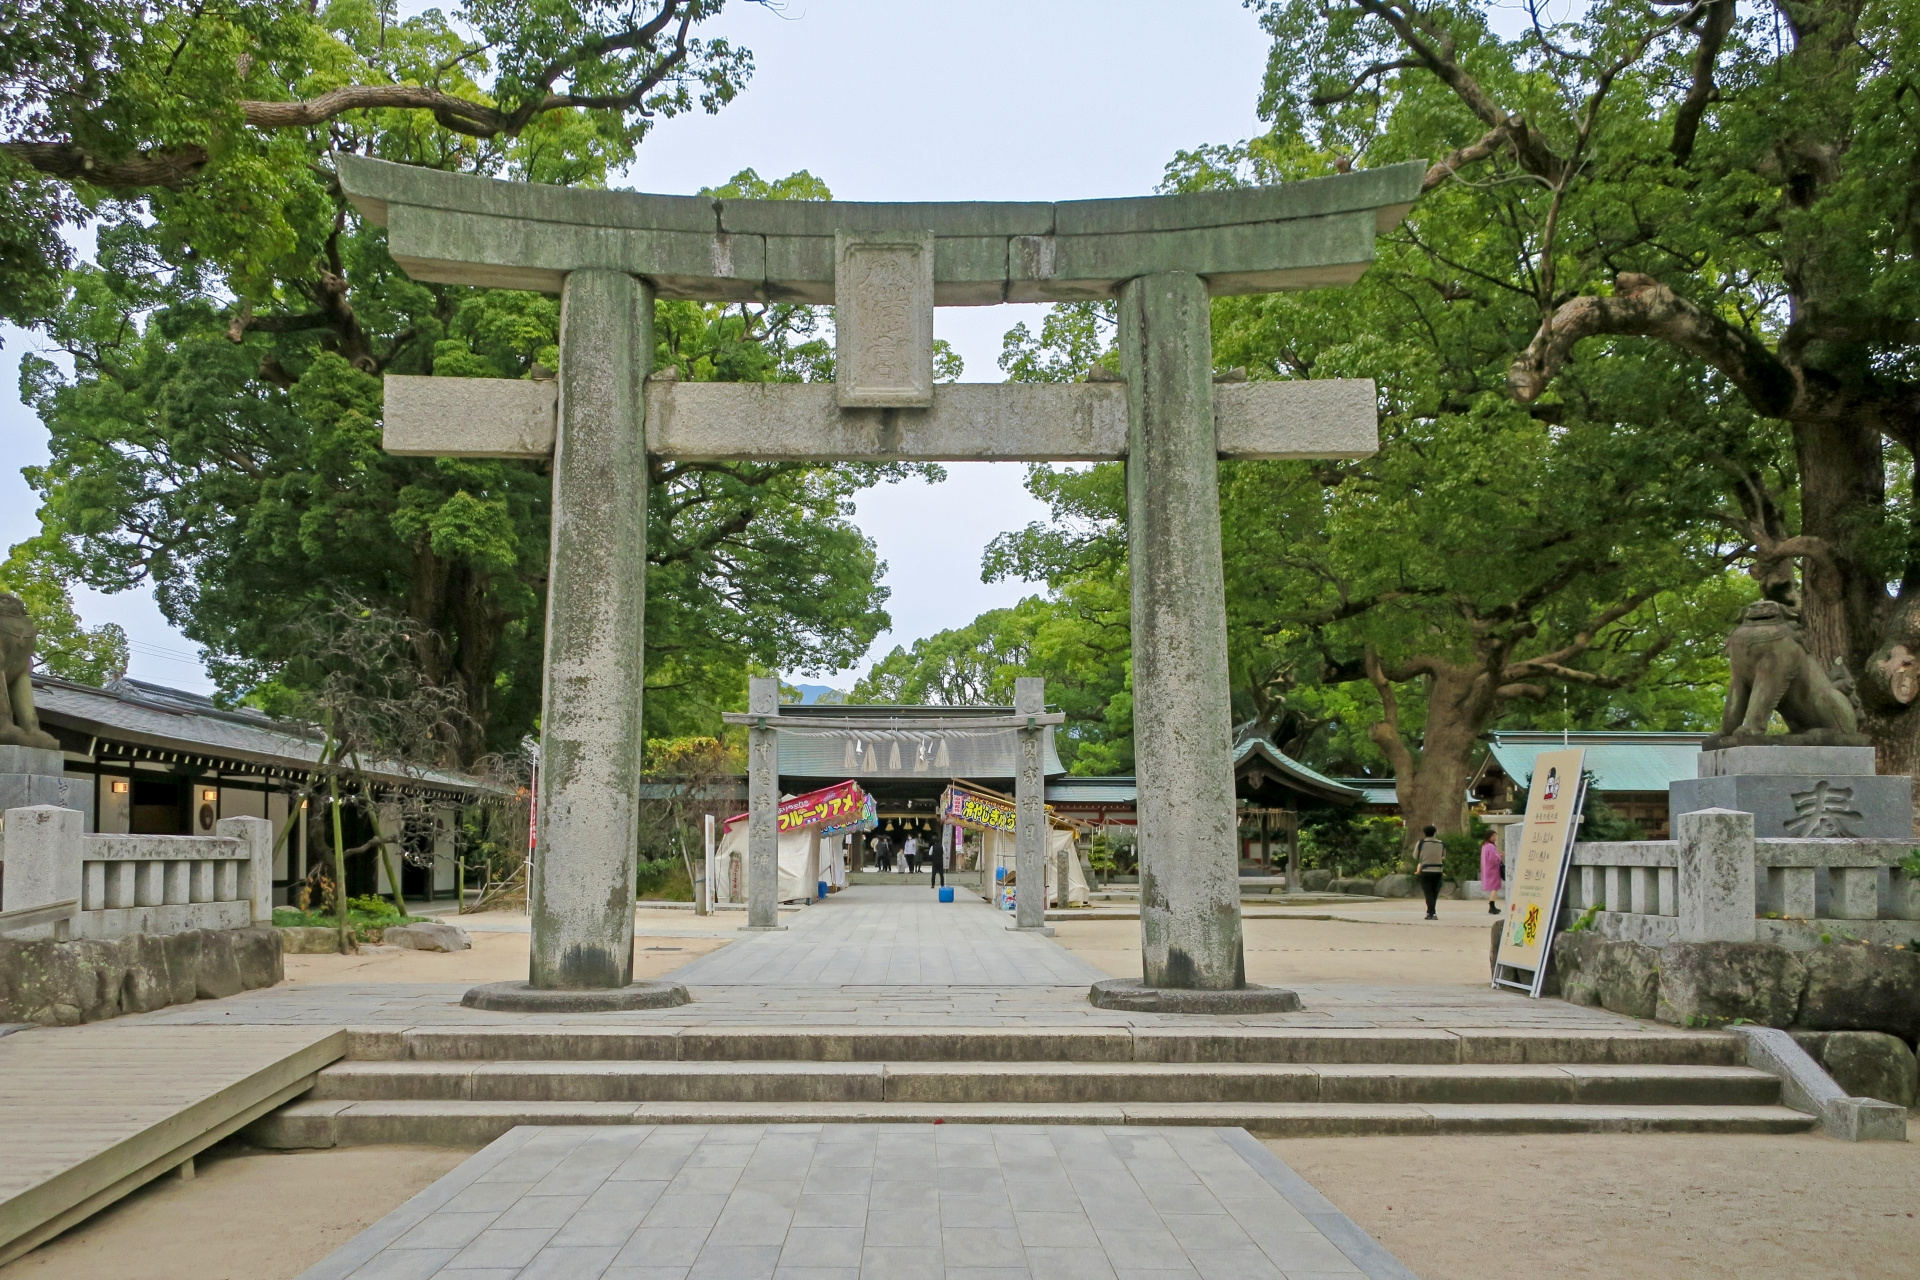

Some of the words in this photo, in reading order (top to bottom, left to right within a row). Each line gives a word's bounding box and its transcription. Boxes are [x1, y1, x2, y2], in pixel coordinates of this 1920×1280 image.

[778, 794, 853, 830] フルーツアメ
[963, 801, 1016, 830] 冷やしきゅう
[1783, 780, 1863, 838] 奉
